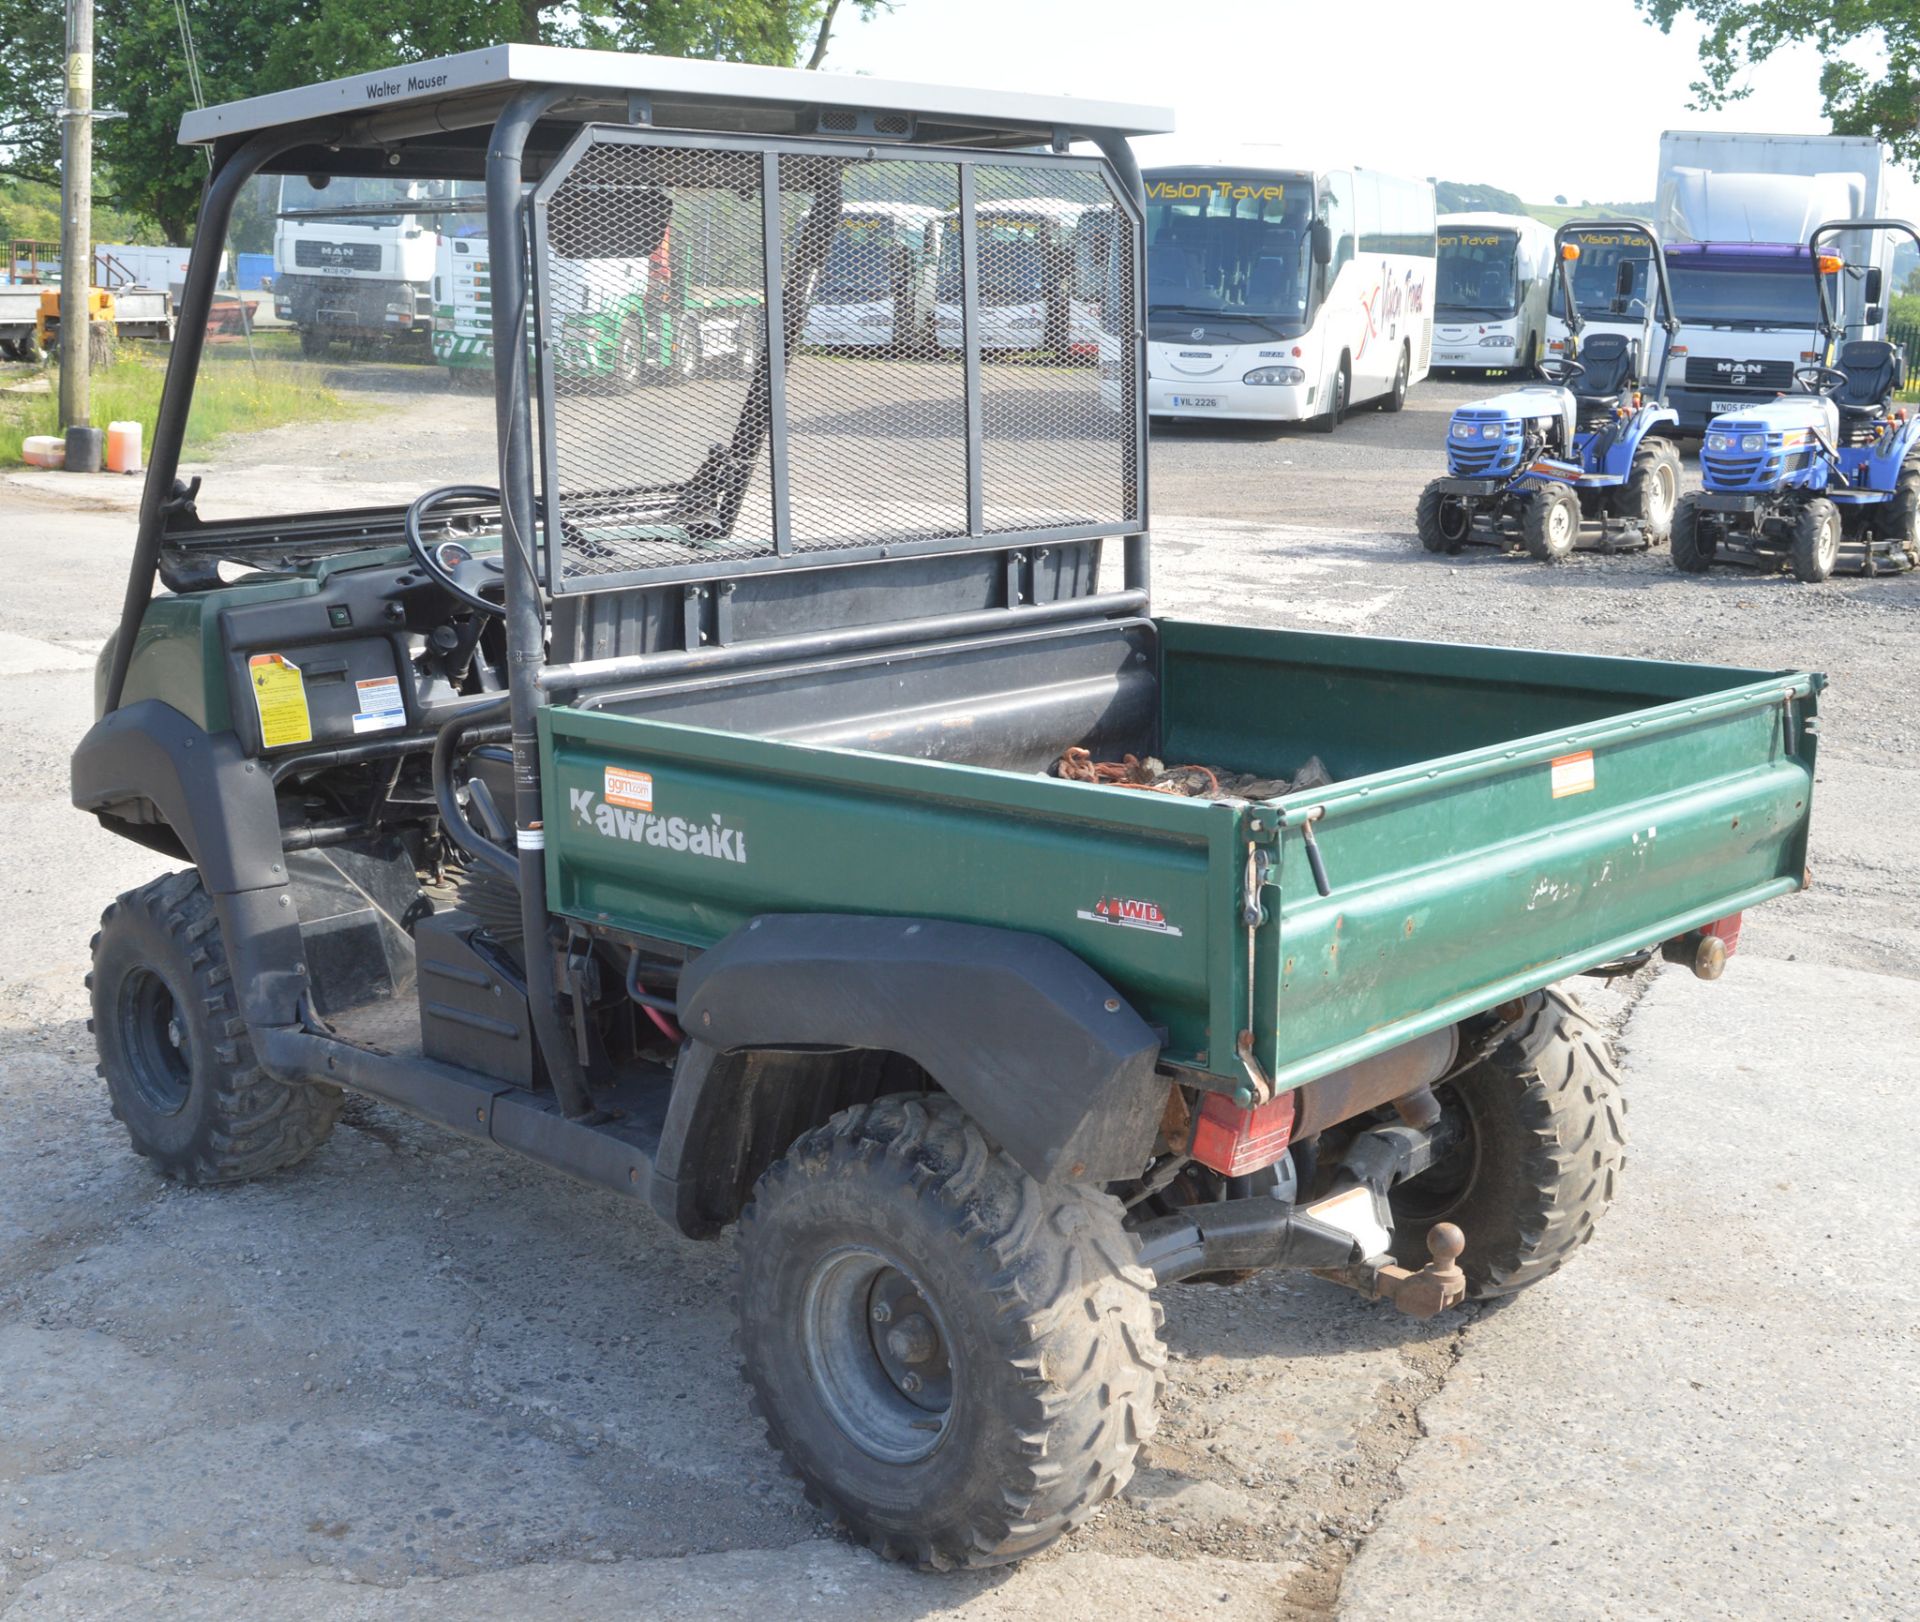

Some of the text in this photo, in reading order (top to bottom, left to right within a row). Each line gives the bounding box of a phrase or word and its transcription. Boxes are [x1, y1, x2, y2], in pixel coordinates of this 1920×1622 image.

[366, 75, 448, 99] Walter Mauser
[1144, 182, 1284, 200] Vision Travel
[1459, 234, 1499, 246] Travel
[1578, 233, 1651, 247] Vision Trav
[321, 247, 354, 256] MAN
[1717, 362, 1762, 374] MAN
[1180, 398, 1217, 407] VIL 2226
[1715, 403, 1738, 412] YN05
[570, 788, 747, 864] Kawasaki
